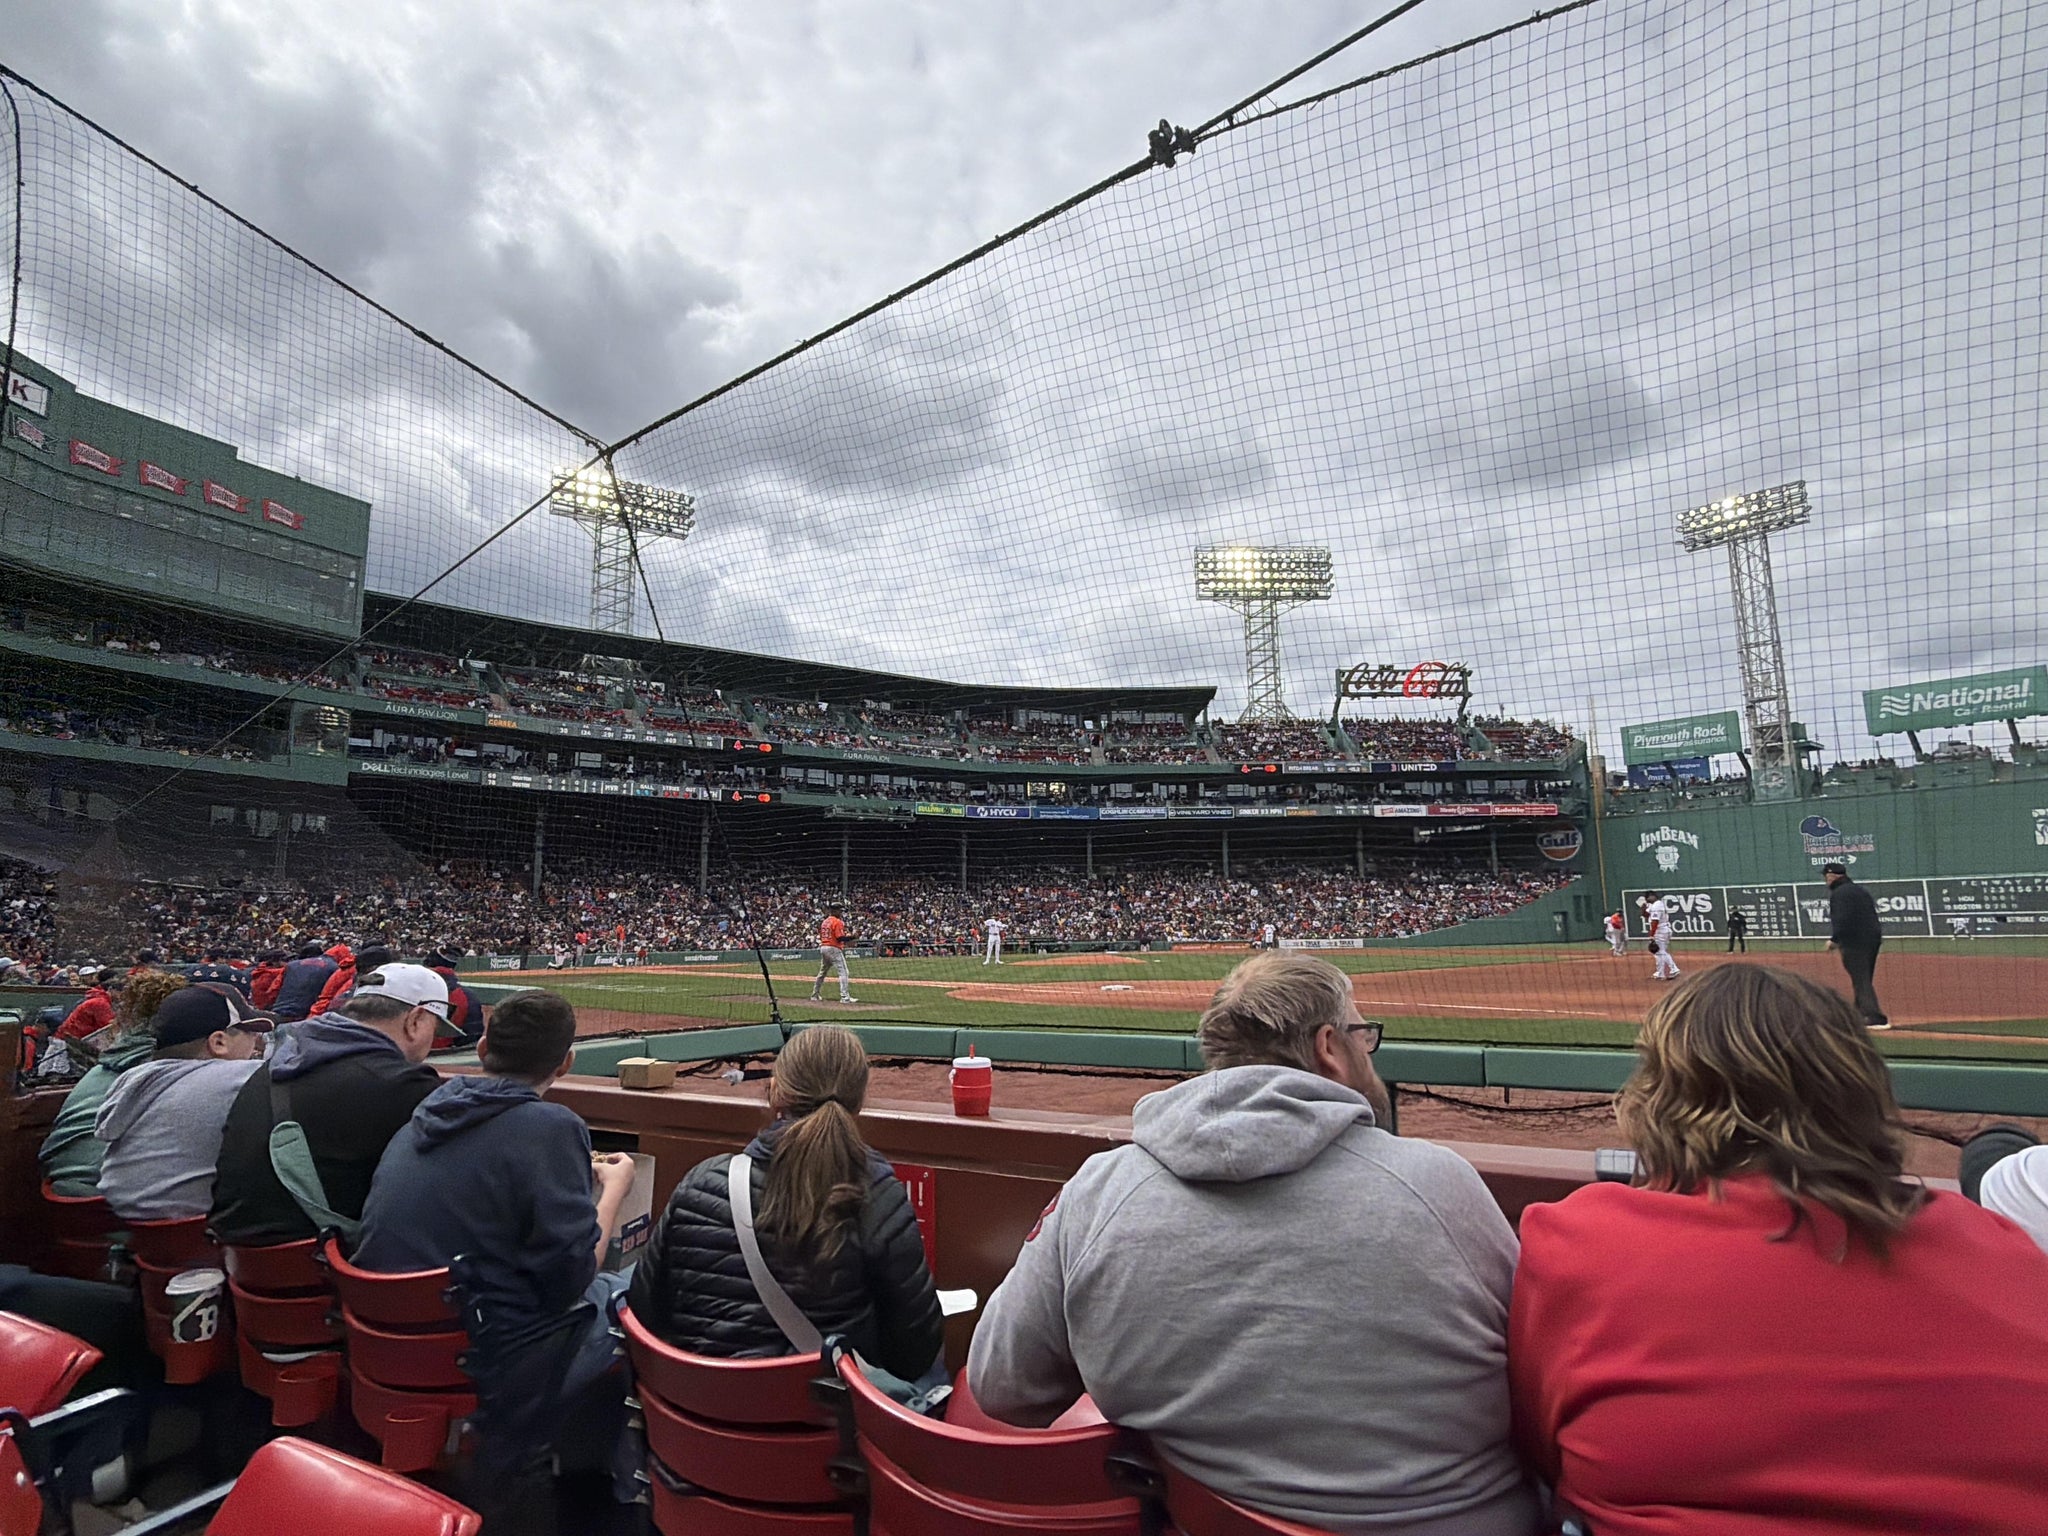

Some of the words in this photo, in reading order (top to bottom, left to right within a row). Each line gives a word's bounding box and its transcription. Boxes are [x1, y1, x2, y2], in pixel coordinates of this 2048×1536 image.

[1912, 678, 2030, 712] National
[417, 708, 458, 720] PAVILION
[1953, 707, 1977, 717] Car
[1982, 700, 2027, 714] Rental
[488, 719, 518, 729] CORREA
[1634, 729, 1690, 747] Plymouth
[1692, 724, 1726, 739] Rock
[863, 753, 889, 762] PAVILION
[362, 762, 390, 773] DELL
[390, 765, 445, 778] Technologies
[447, 769, 469, 780] Level
[1401, 763, 1438, 772] UNITED
[990, 808, 1017, 817] HYCU
[1541, 832, 1579, 848] Gulf
[1637, 832, 1661, 852] JIM
[1660, 826, 1699, 849] BEAM
[1811, 856, 1845, 866] BIDMC
[1662, 893, 1713, 914] CVS
[1875, 895, 1925, 913] SON
[684, 954, 719, 962] smartwater
